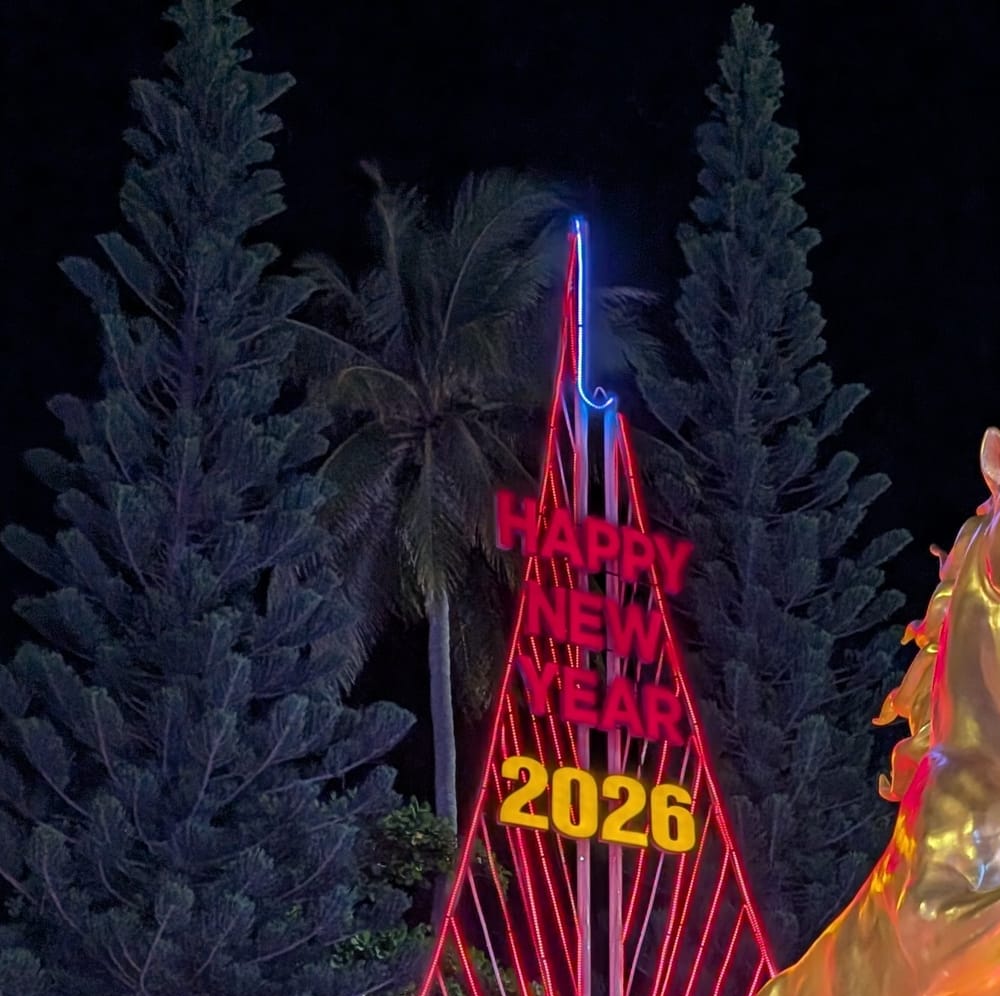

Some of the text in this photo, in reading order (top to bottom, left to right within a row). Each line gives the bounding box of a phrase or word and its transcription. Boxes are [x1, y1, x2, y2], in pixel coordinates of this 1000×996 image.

[496, 491, 692, 594] HAPPY
[525, 581, 662, 663] NEW
[519, 656, 683, 744] YEAR
[498, 755, 696, 853] 2026
